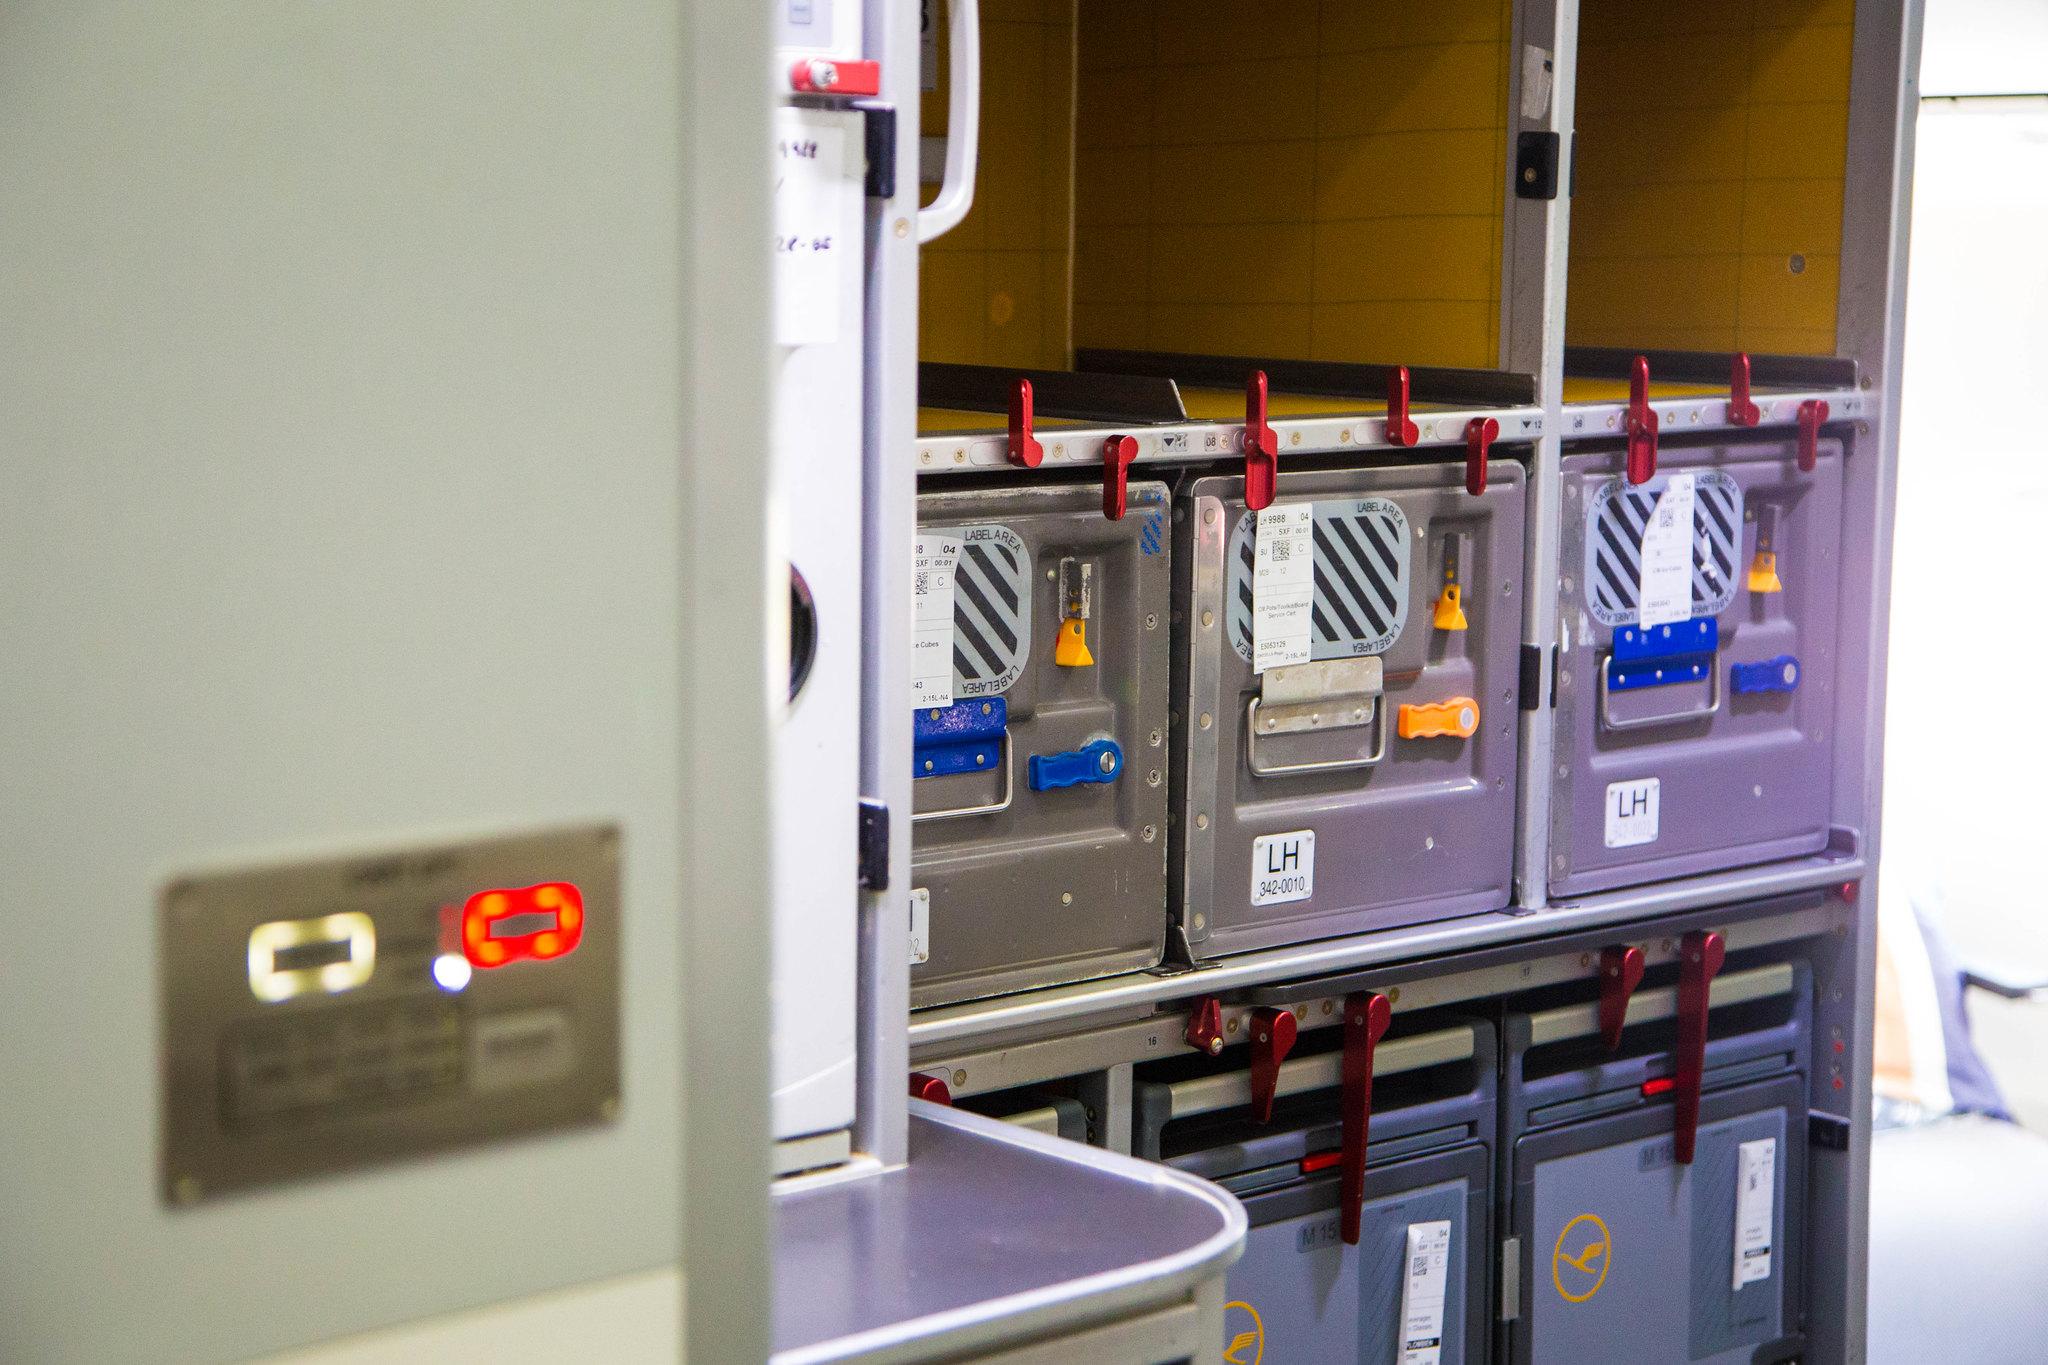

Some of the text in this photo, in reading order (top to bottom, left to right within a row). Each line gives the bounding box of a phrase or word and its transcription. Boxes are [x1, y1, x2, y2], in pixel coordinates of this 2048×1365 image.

[1206, 437, 1217, 447] 08
[1239, 511, 1256, 533] LAB
[1268, 514, 1286, 524] 9988
[1300, 512, 1309, 521] 04
[1358, 502, 1404, 528] LABEL AREA
[965, 529, 1021, 554] LABEL AREA
[1279, 527, 1291, 536] SXF
[942, 544, 956, 554] 04
[915, 559, 952, 568] SXF 00:01
[937, 576, 944, 587] C
[1353, 623, 1400, 653] LABEL AREA
[1236, 638, 1253, 660] REA
[962, 664, 1019, 694] LABEL AREA
[1619, 788, 1648, 818] LH
[1268, 840, 1299, 873] LH
[1260, 876, 1304, 897] 342-0010
[1148, 1036, 1157, 1046] 16
